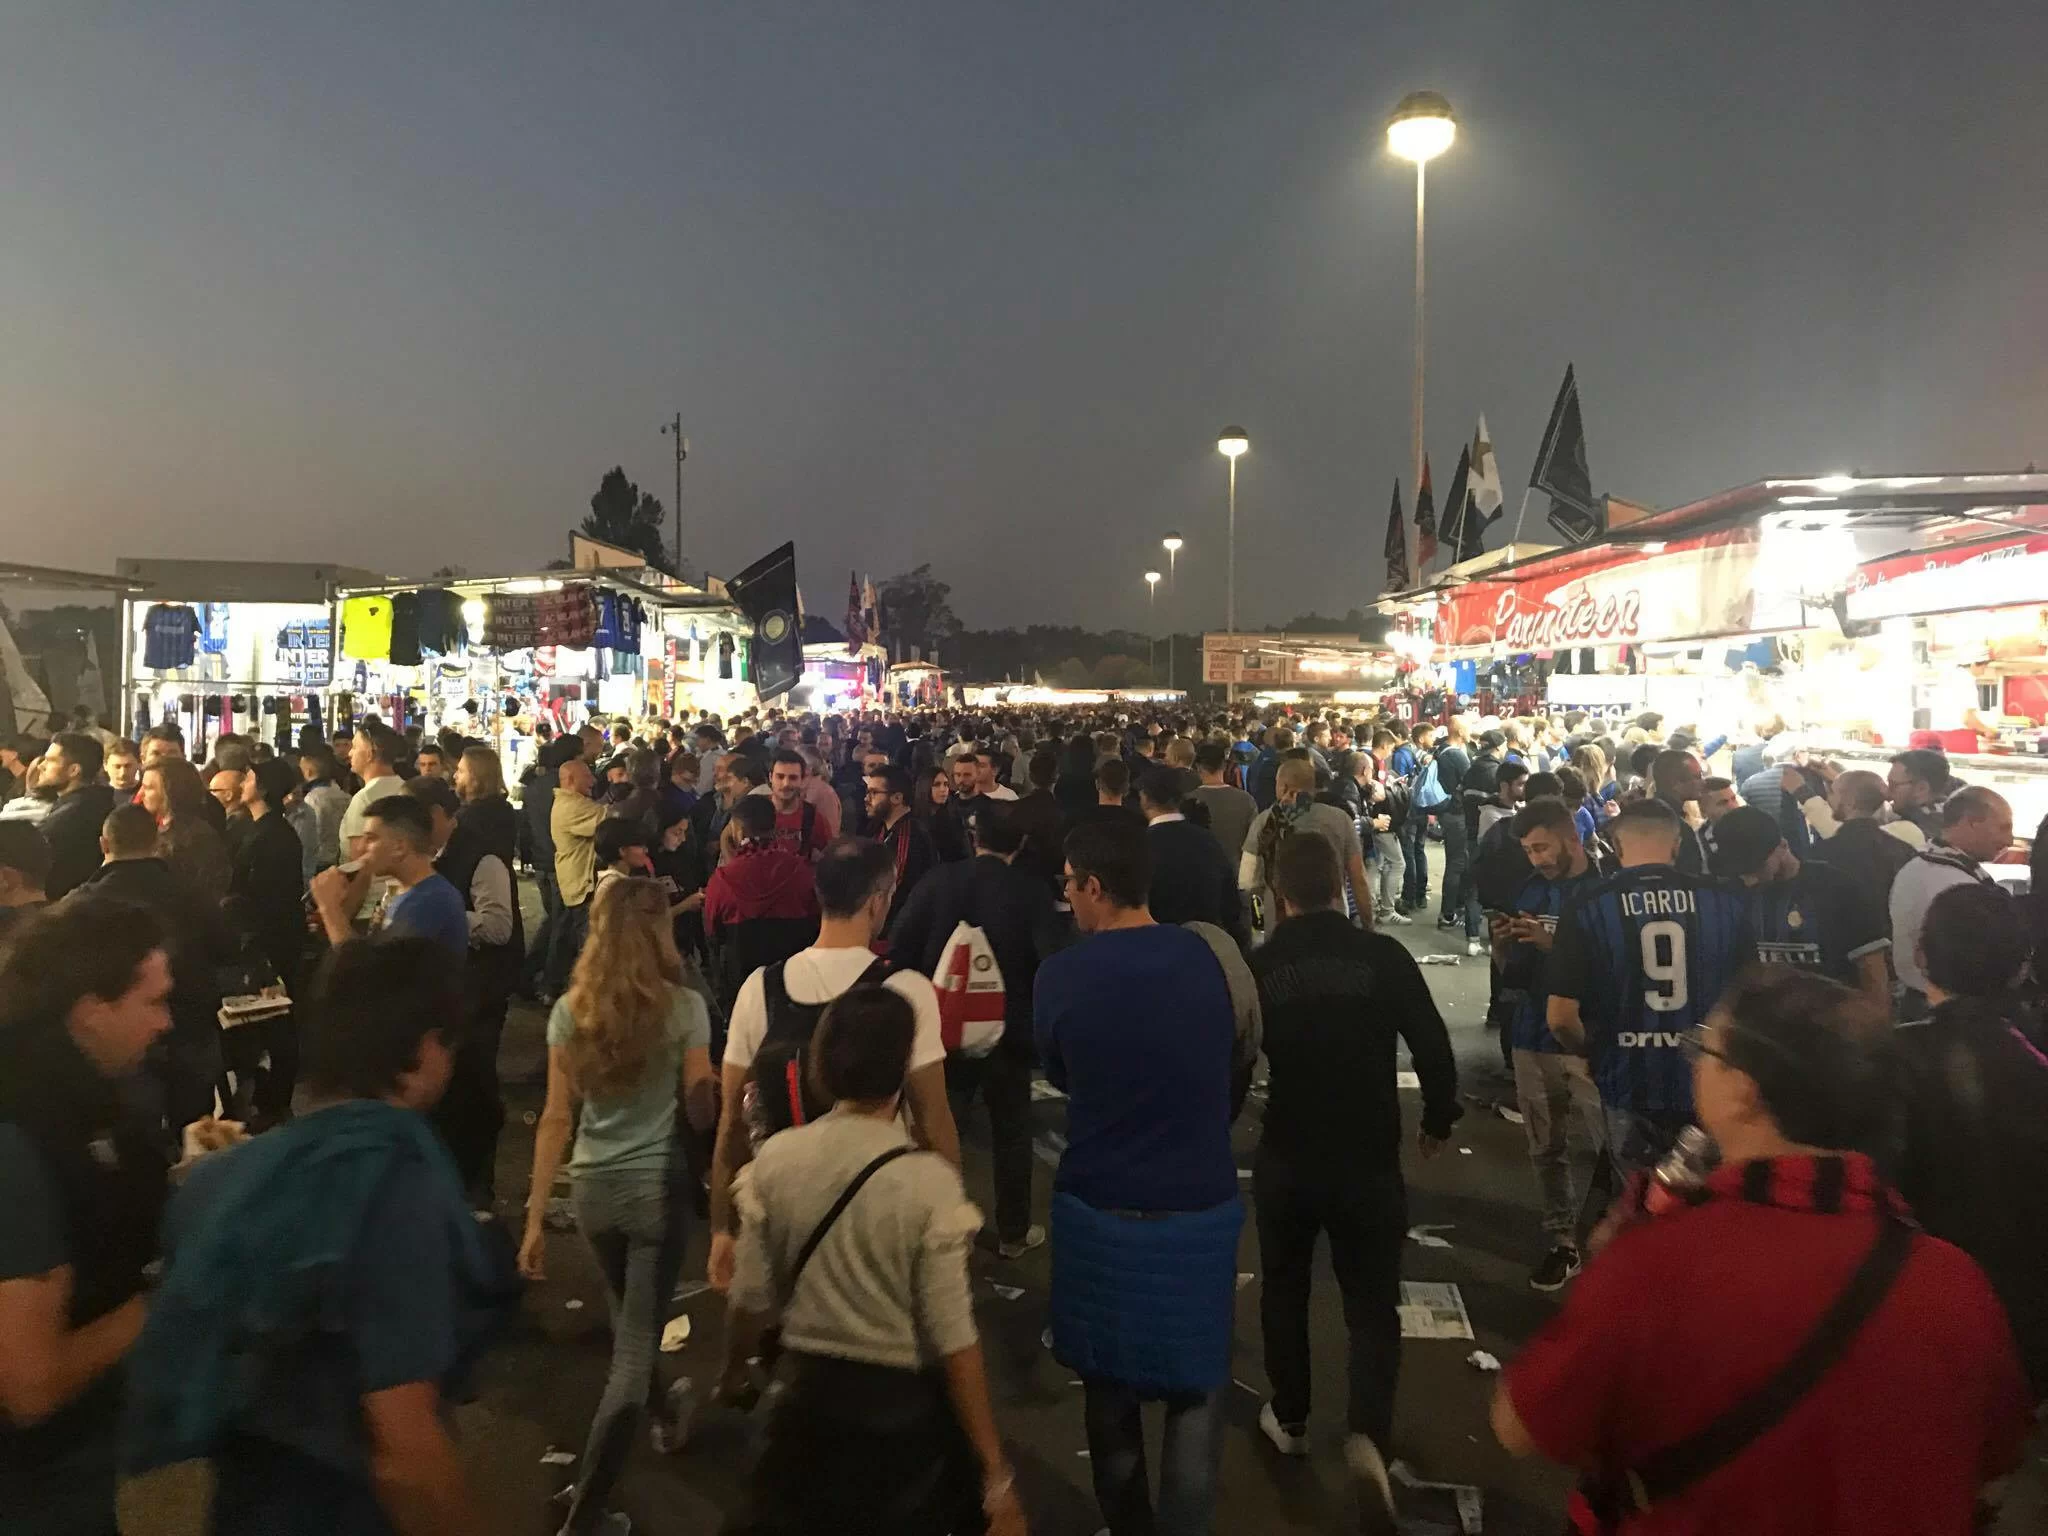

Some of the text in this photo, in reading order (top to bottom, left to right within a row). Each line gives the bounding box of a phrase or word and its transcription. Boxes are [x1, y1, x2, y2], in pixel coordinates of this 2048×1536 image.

[1397, 703, 1413, 720] 10
[1621, 890, 1696, 917] ICARDI
[1640, 920, 1688, 1012] 9
